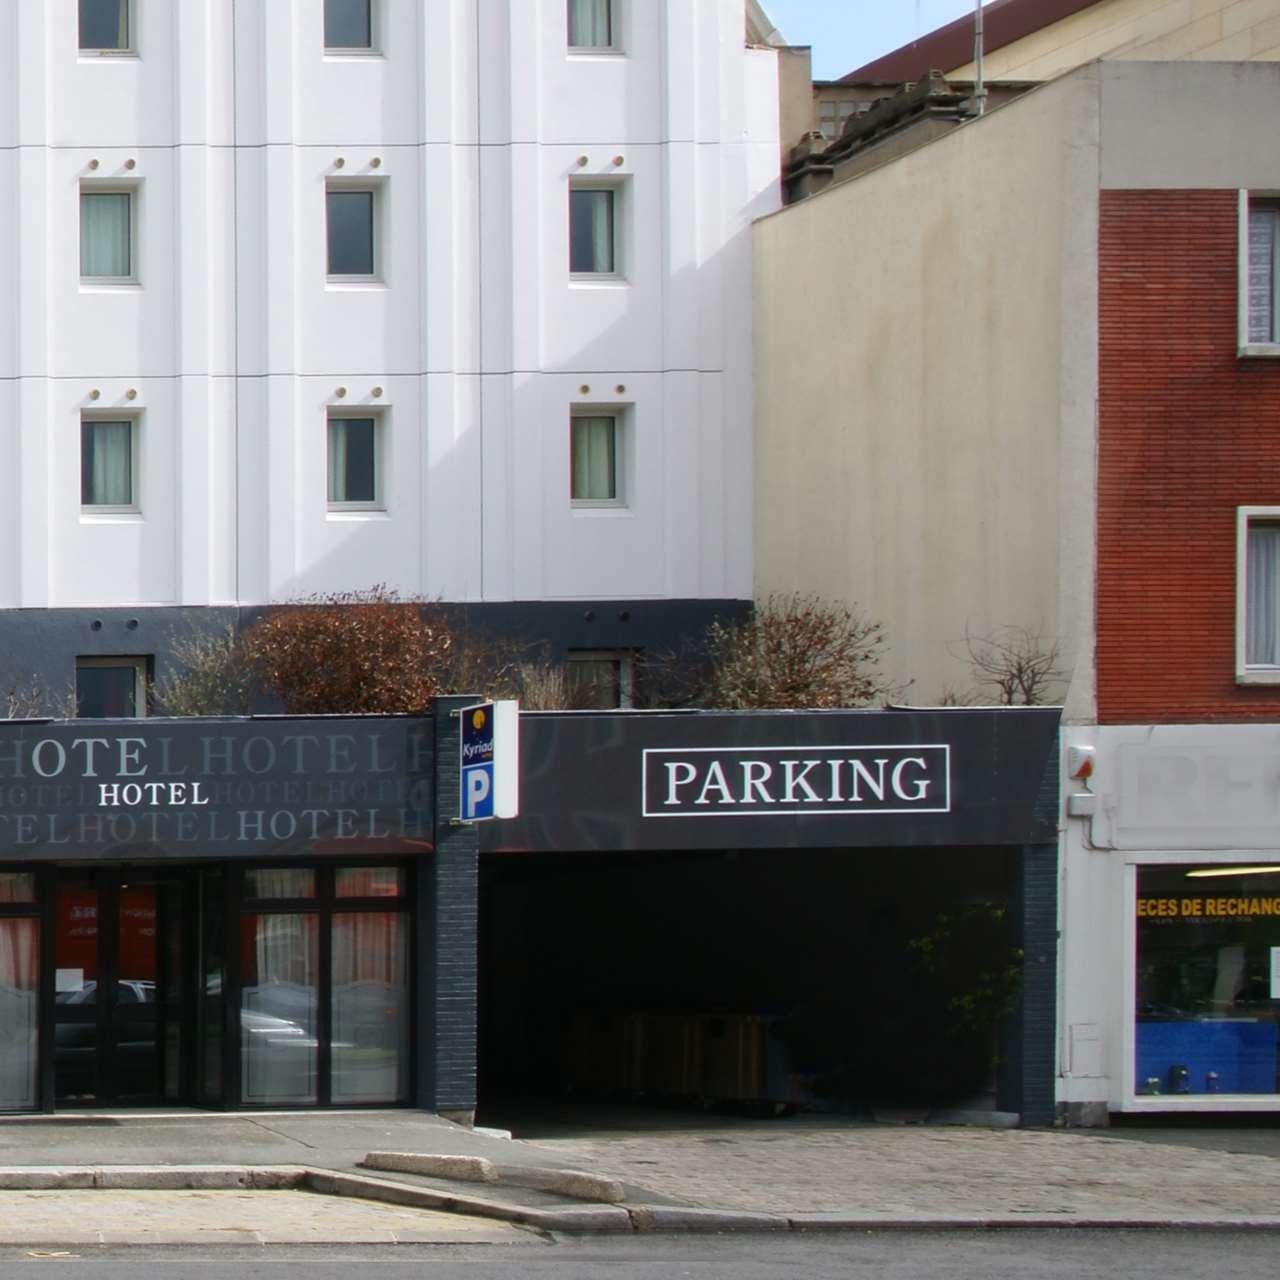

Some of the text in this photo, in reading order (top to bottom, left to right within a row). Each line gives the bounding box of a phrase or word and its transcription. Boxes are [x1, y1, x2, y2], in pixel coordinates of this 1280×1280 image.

[463, 737, 494, 759] Kyriad
[467, 769, 490, 818] P
[663, 757, 931, 806] PARKING
[97, 782, 210, 807] HOTEL
[1182, 899, 1202, 916] DE
[1206, 898, 1280, 916] RECHANG
